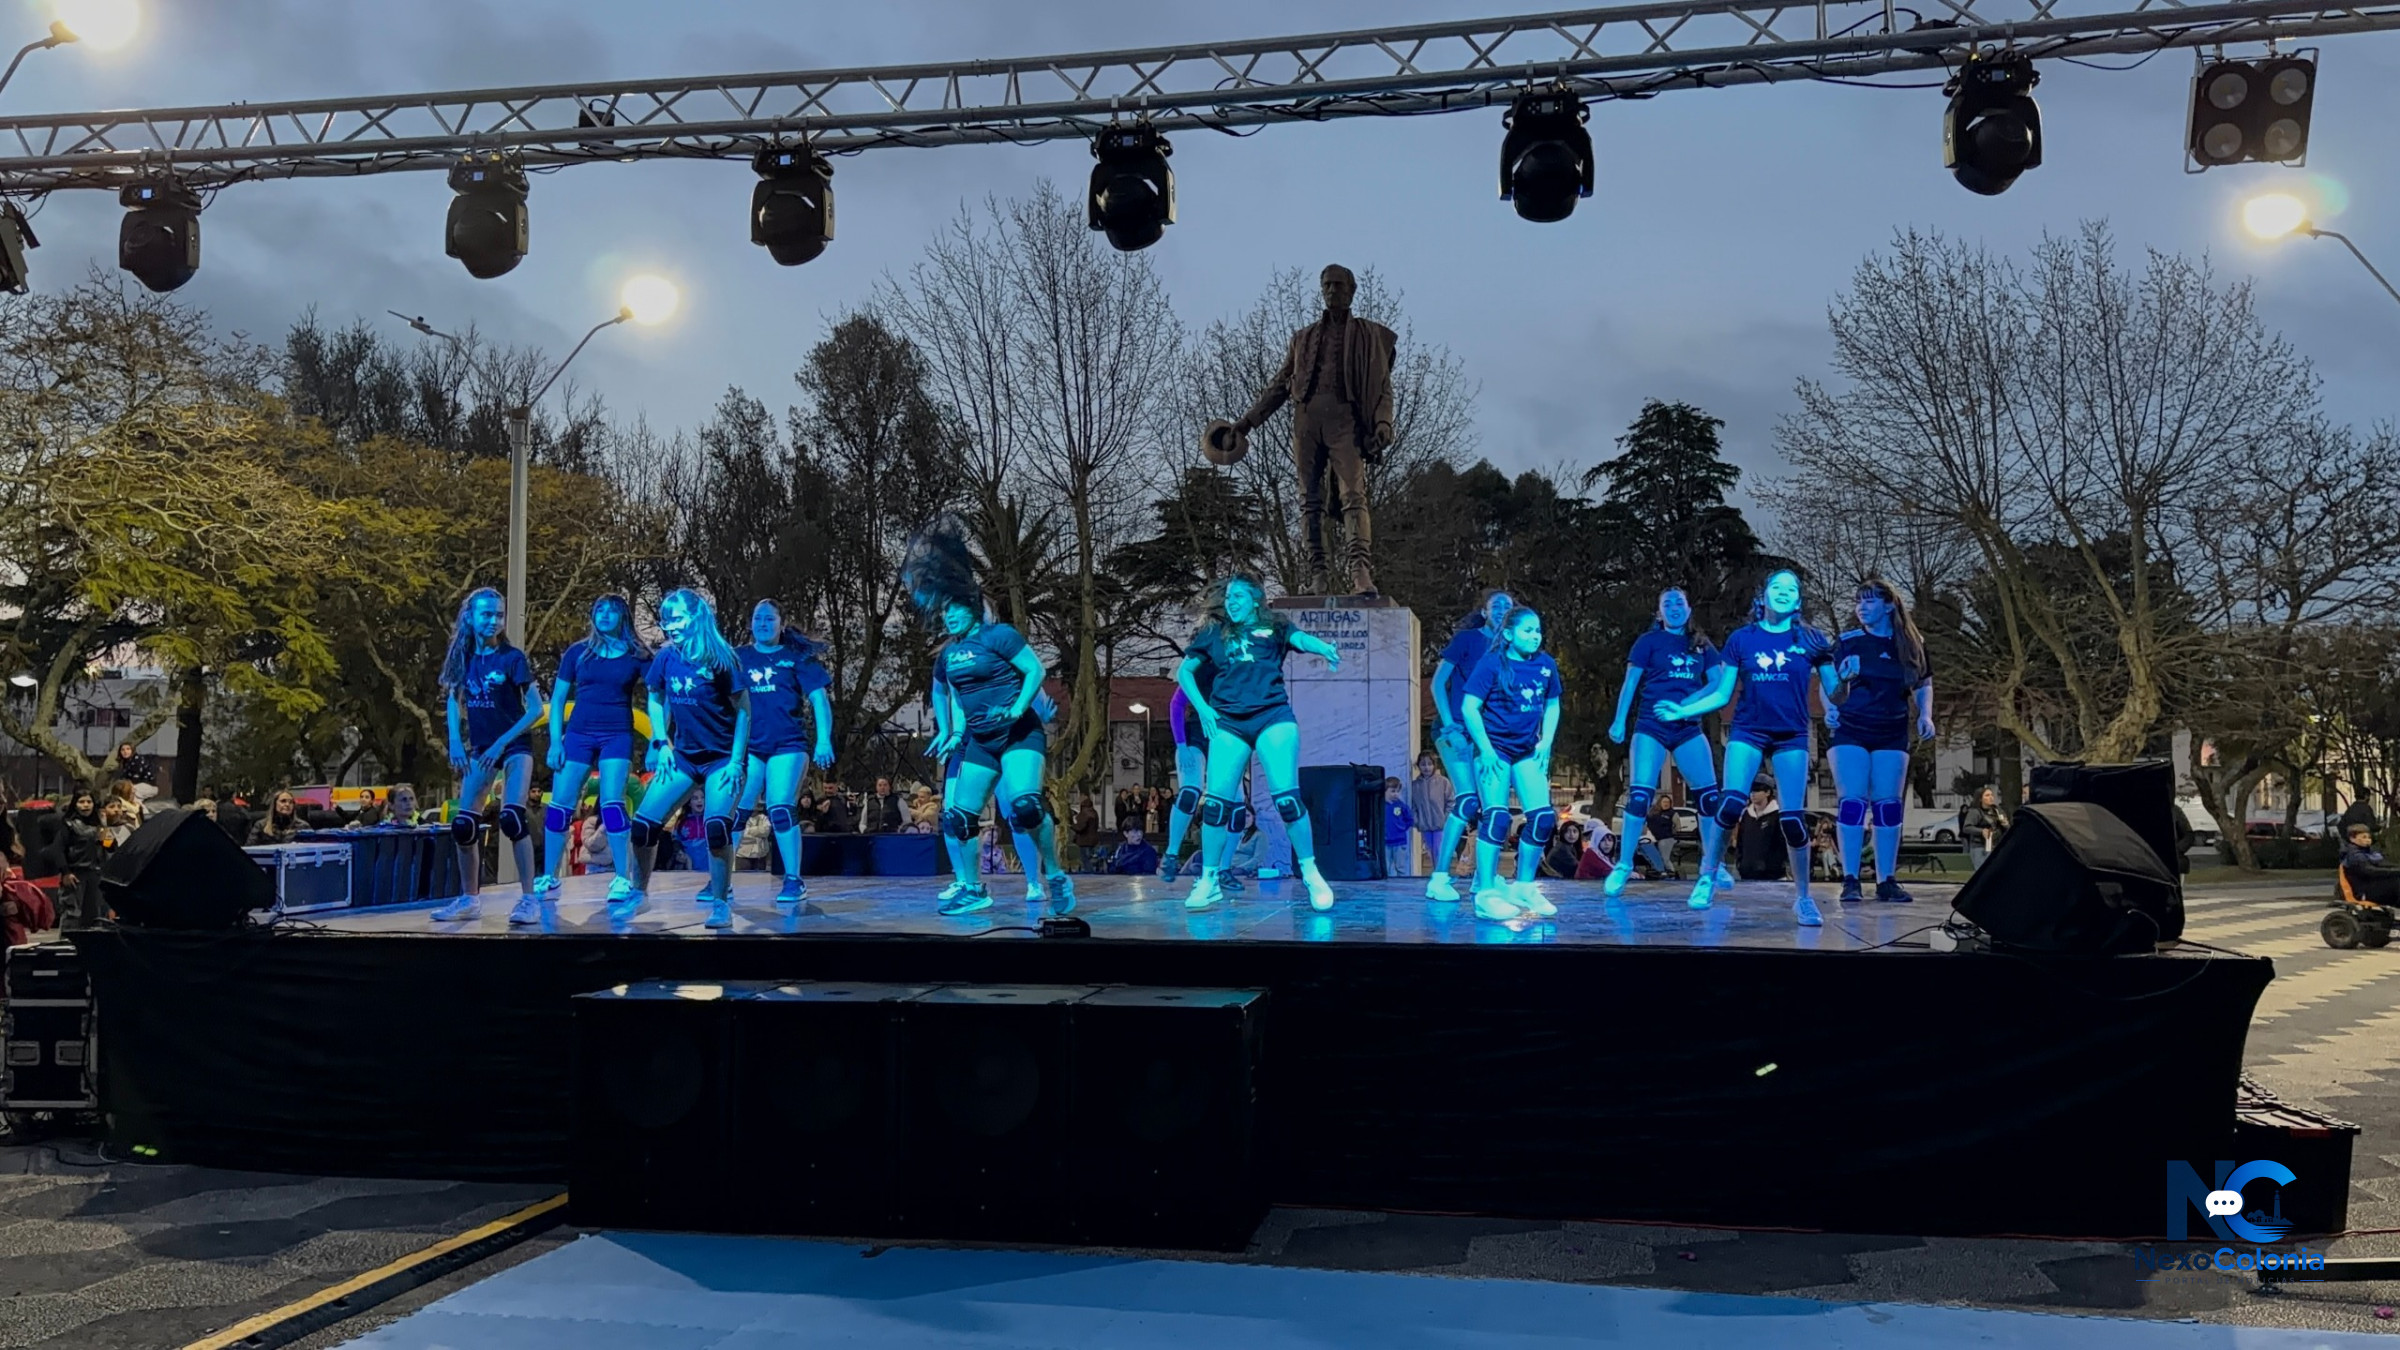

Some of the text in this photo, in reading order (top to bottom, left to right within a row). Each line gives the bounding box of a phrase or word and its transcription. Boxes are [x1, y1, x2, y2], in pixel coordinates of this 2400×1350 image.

[1300, 610, 1361, 623] ARTIGAS
[1341, 630, 1350, 638] DE
[1352, 630, 1369, 638] LOS
[1751, 672, 1790, 682] DANCER
